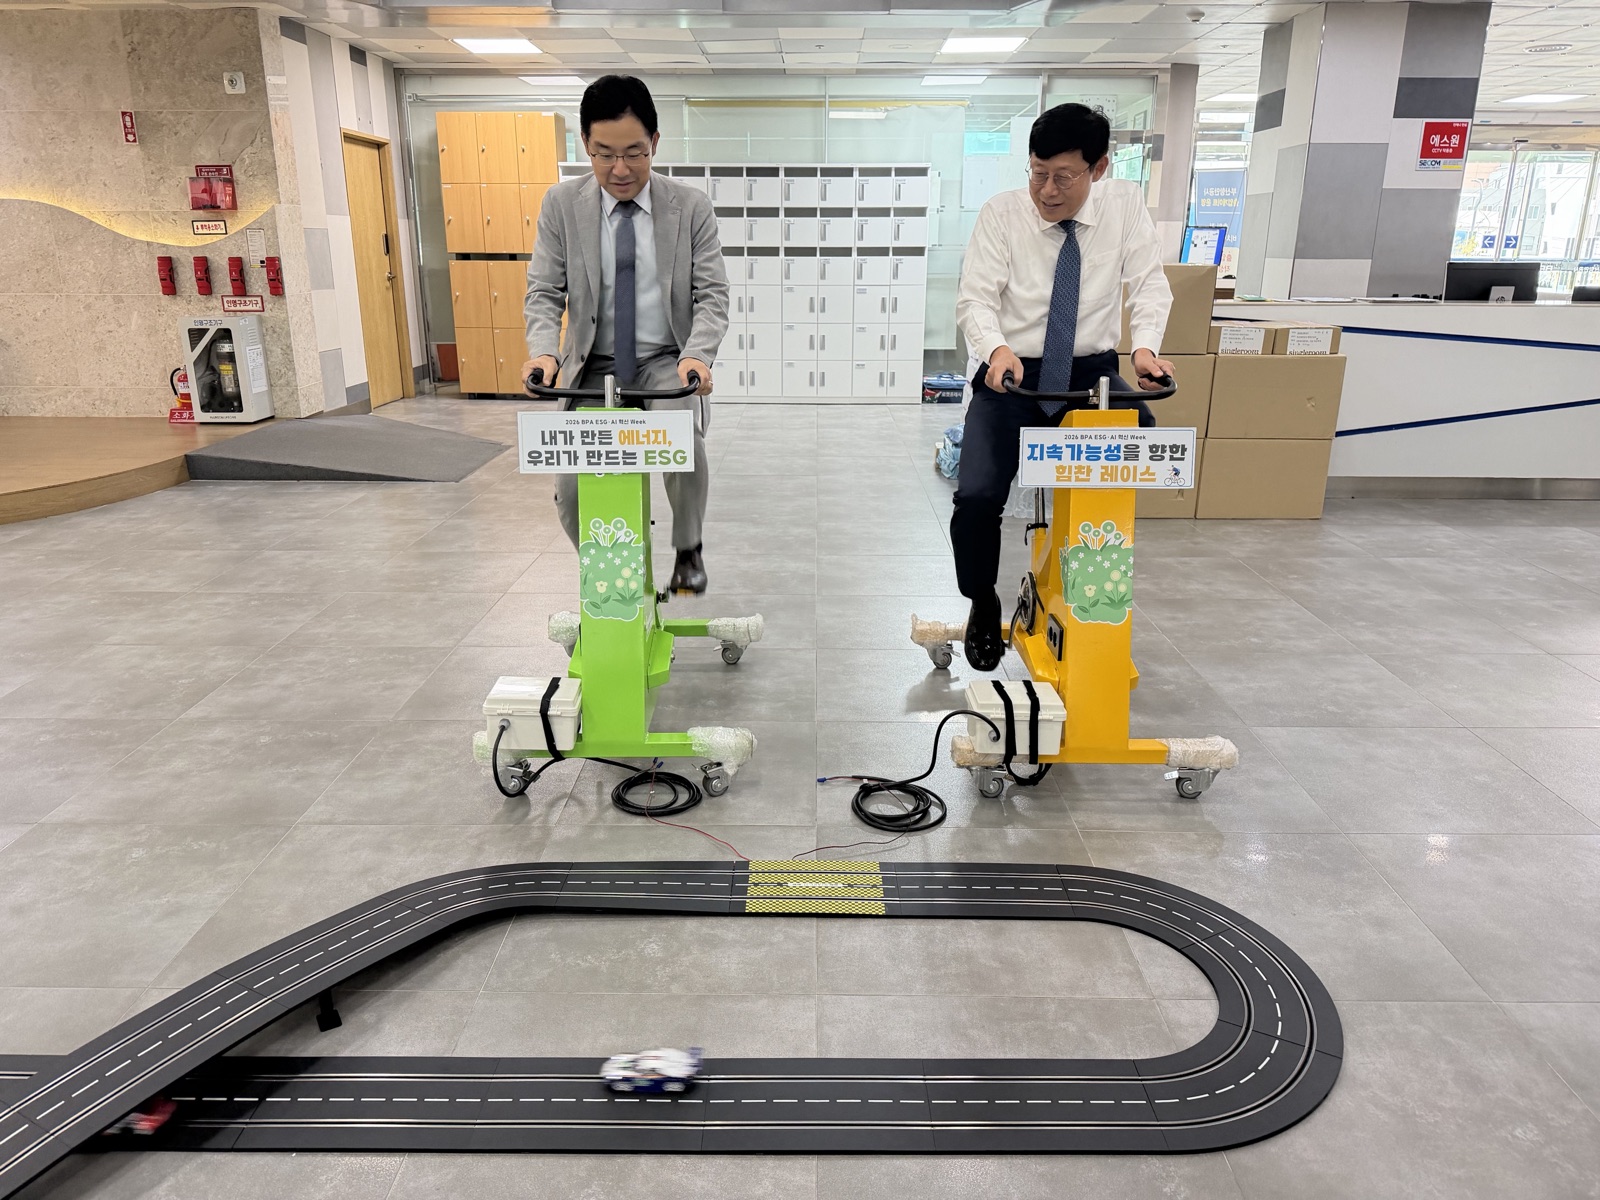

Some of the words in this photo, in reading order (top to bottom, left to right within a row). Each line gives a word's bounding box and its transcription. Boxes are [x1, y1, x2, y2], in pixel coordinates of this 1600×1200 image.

[1430, 134, 1460, 148] 에스원
[226, 300, 259, 308] 인명구조기구
[541, 430, 575, 446] 내가
[580, 430, 613, 446] 만든
[618, 429, 672, 447] 에너지,
[527, 450, 579, 466] 우리가
[586, 450, 637, 466] 만드는
[644, 450, 687, 465] ESG
[1027, 444, 1140, 462] 지속가능성을
[1148, 444, 1187, 462] 향한
[1055, 465, 1092, 482] 힘찬
[1100, 465, 1157, 482] 레이스
